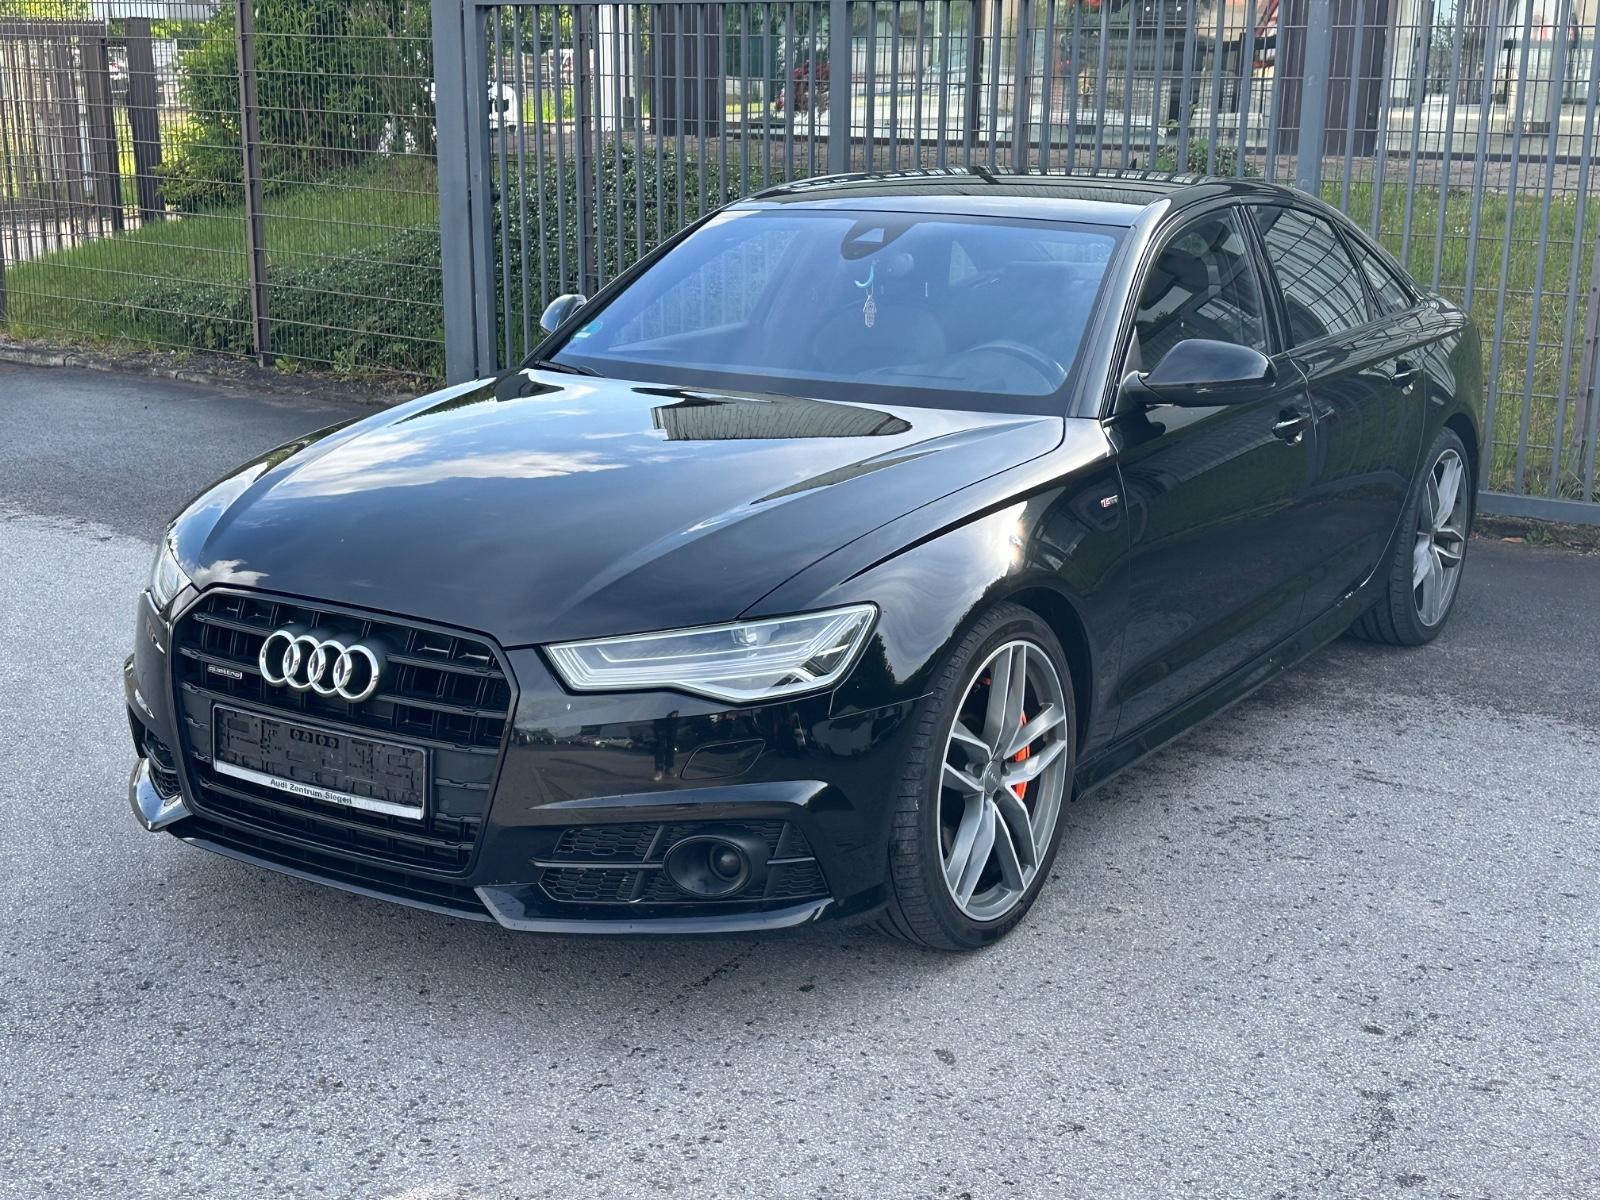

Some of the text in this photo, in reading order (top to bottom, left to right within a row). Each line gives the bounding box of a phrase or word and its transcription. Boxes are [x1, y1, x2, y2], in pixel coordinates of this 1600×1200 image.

[270, 778, 352, 805] Audi Zentrum Siegen
